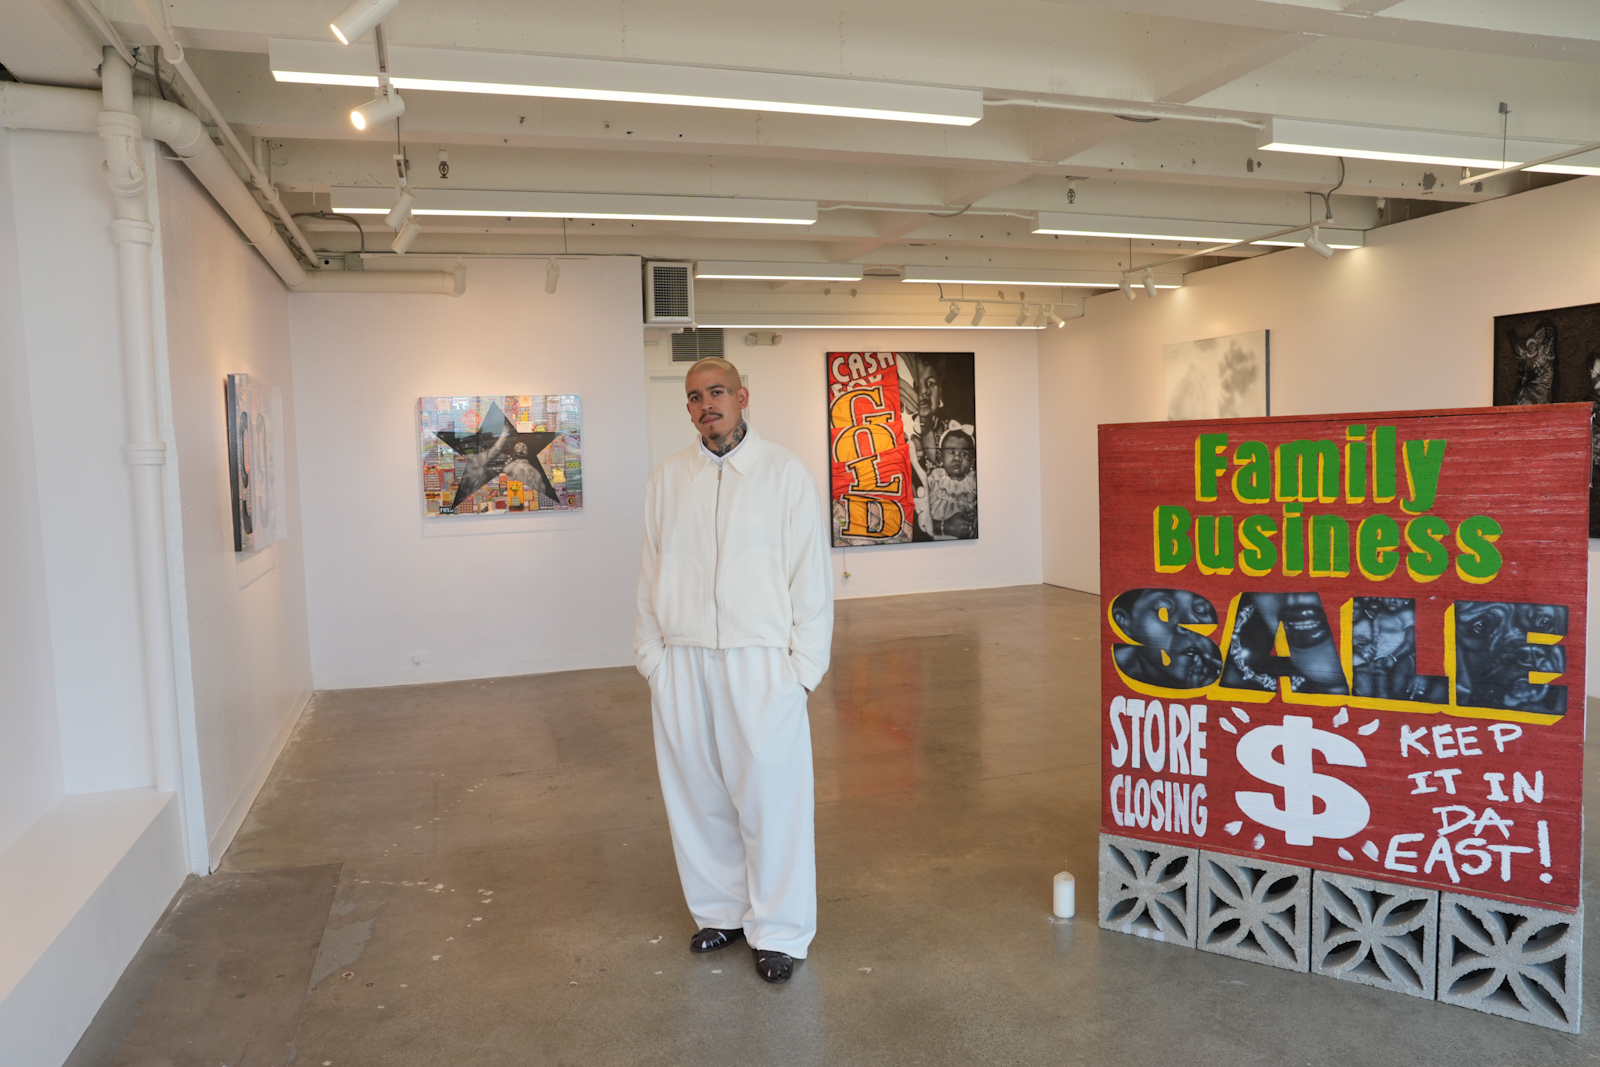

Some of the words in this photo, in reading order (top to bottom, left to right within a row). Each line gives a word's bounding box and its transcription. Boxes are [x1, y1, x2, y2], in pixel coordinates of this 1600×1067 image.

[832, 352, 895, 382] CASH
[830, 385, 905, 541] GOLD
[1195, 424, 1447, 515] Family
[1153, 503, 1503, 584] Business
[1108, 588, 1568, 726] SALE
[1110, 695, 1207, 776] STORE
[1400, 723, 1522, 759] KEEP
[1110, 774, 1208, 837] CLOSING
[1407, 768, 1462, 795] IT
[1483, 770, 1544, 803] IN
[1384, 820, 1552, 884] EAST!
[1432, 804, 1514, 838] DA
